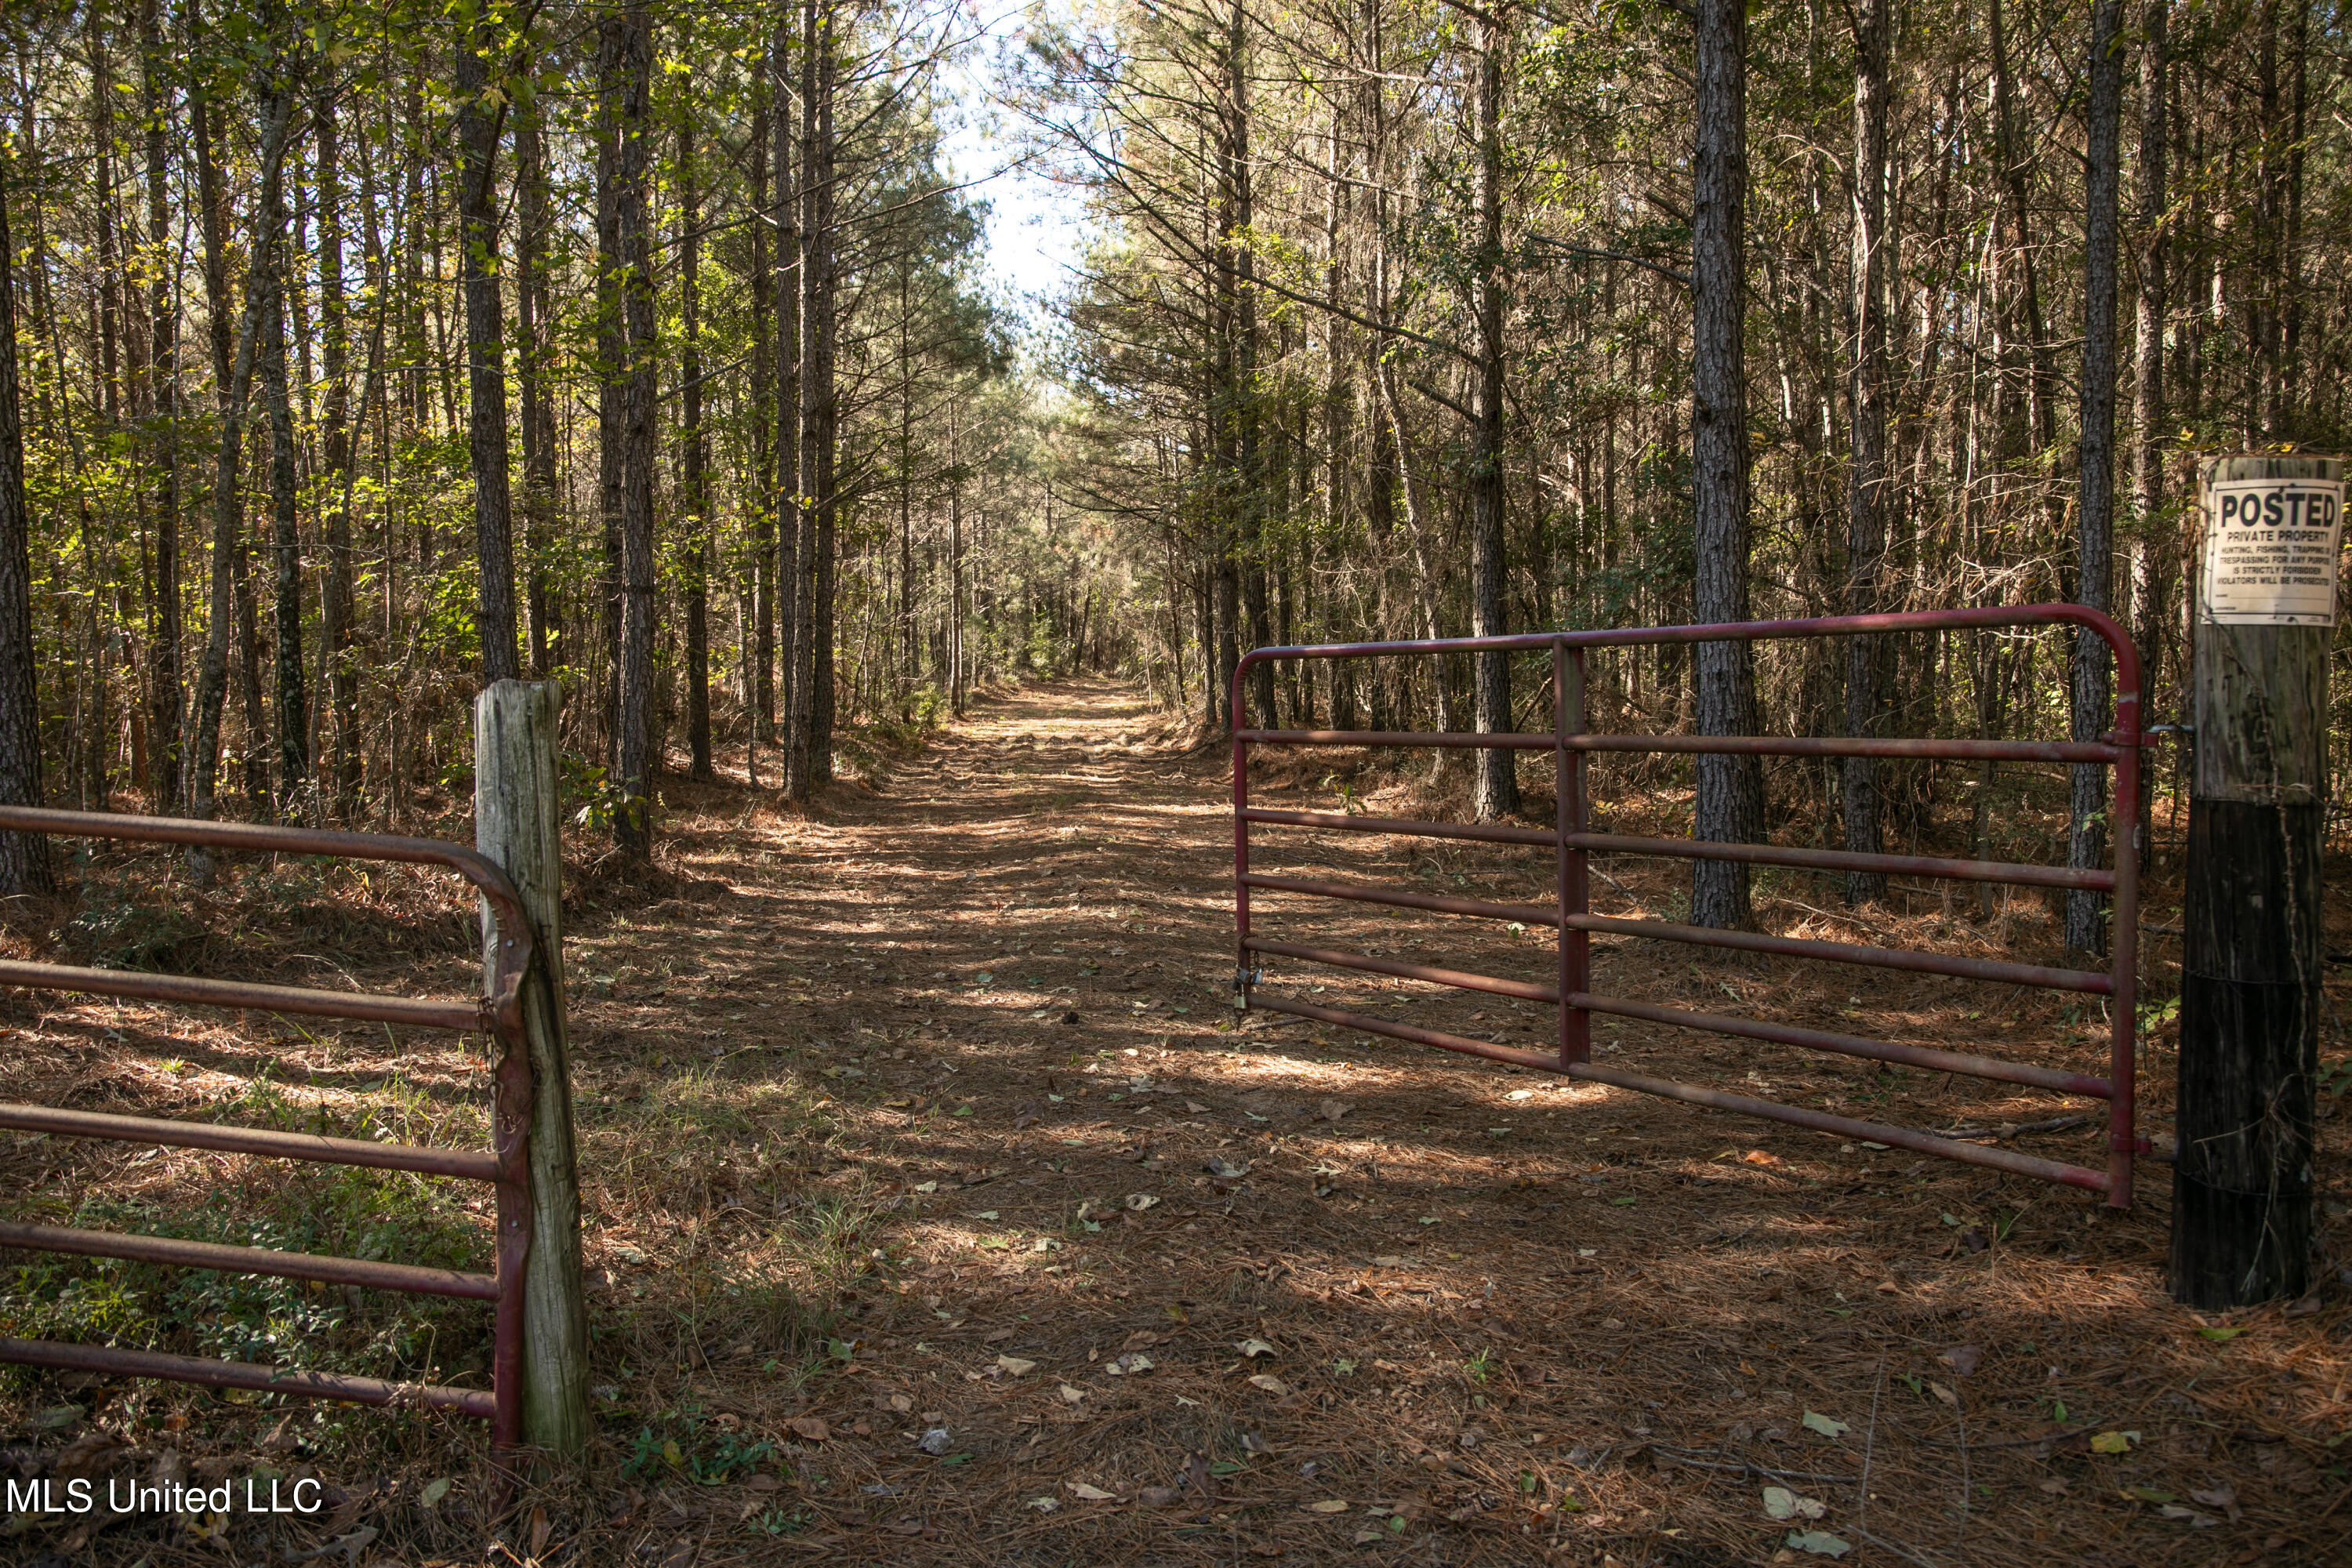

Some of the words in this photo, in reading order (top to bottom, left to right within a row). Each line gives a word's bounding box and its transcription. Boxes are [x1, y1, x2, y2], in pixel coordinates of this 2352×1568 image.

[2221, 492, 2335, 528] POSTED
[2227, 531, 2274, 542] PRIVATE
[2278, 530, 2329, 542] PROPERTY
[2282, 566, 2321, 575] FORBIDDEN
[2216, 576, 2256, 585] VIOLATORS
[2259, 576, 2277, 585] WILL
